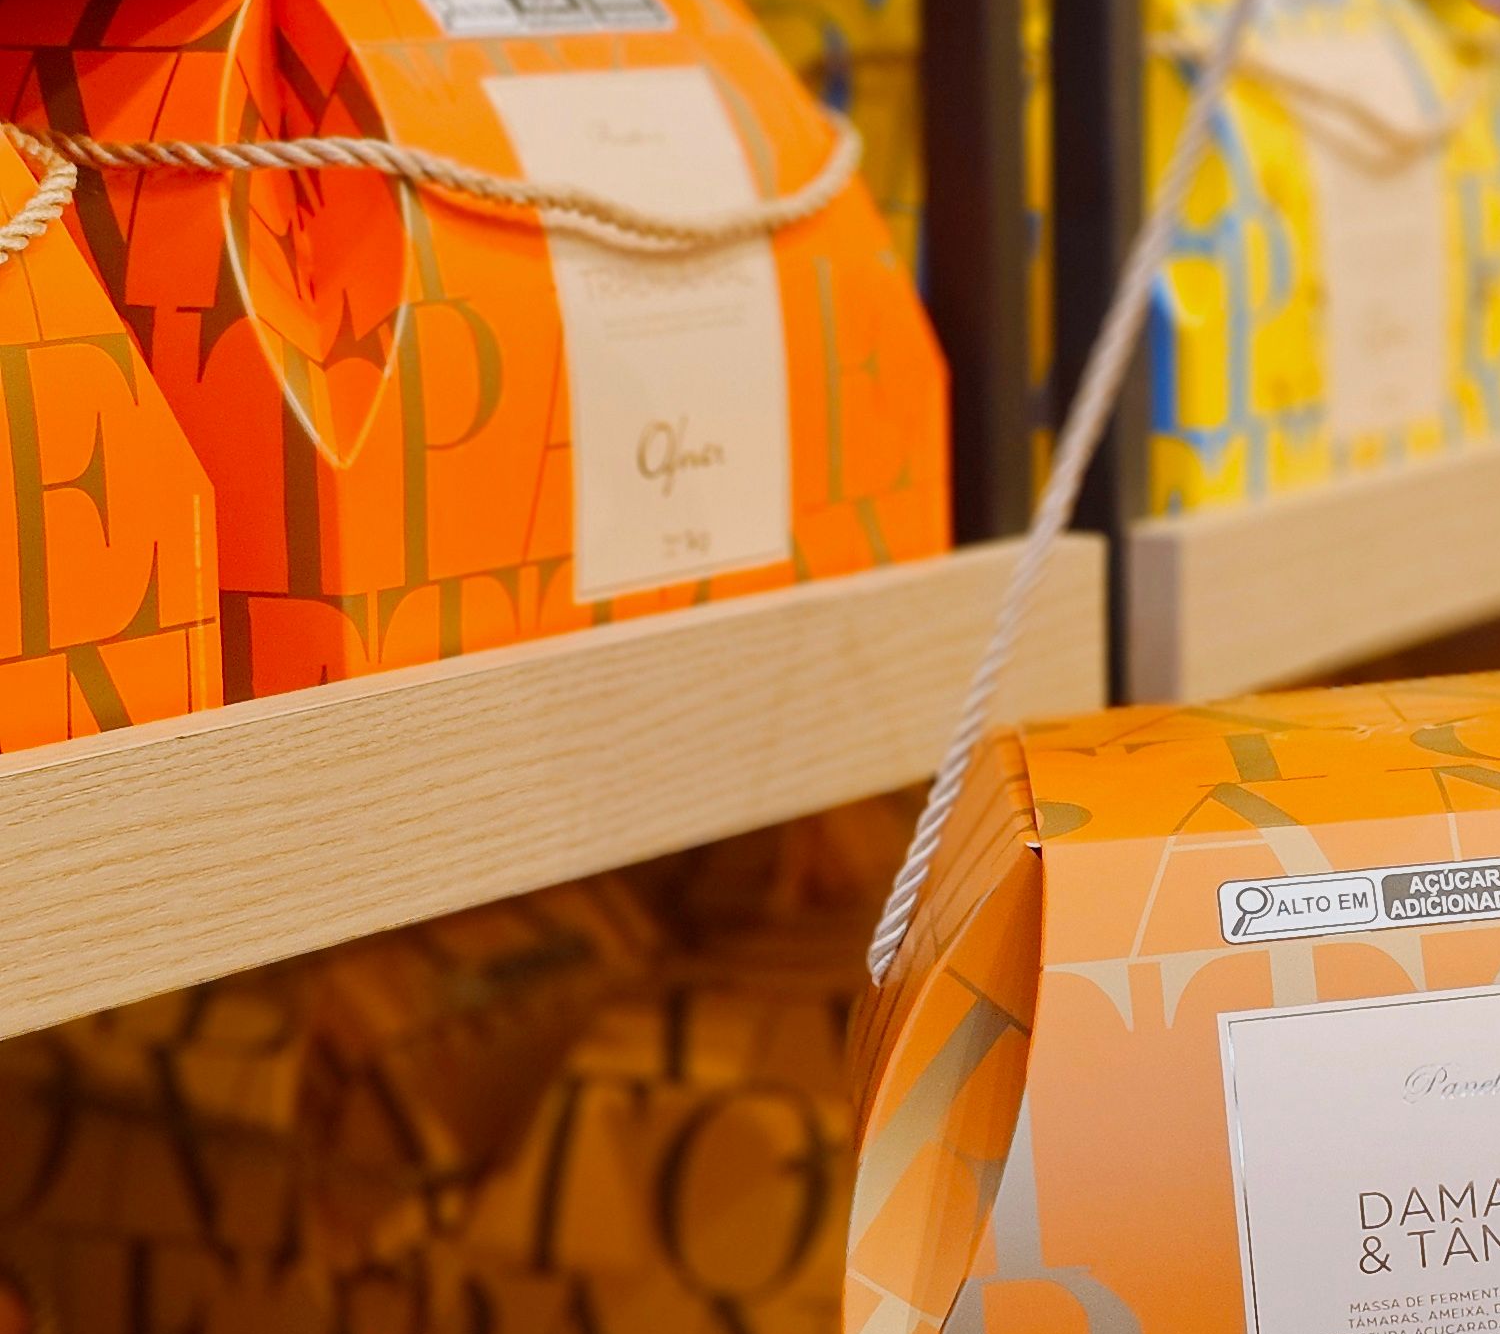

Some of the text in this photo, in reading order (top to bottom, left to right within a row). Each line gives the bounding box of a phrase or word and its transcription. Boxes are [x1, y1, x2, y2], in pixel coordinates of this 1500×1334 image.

[1276, 892, 1370, 917] ALTO EM
[1359, 1235, 1392, 1274] &
[1350, 1298, 1400, 1314] MASSA
[1406, 1295, 1425, 1308] DE
